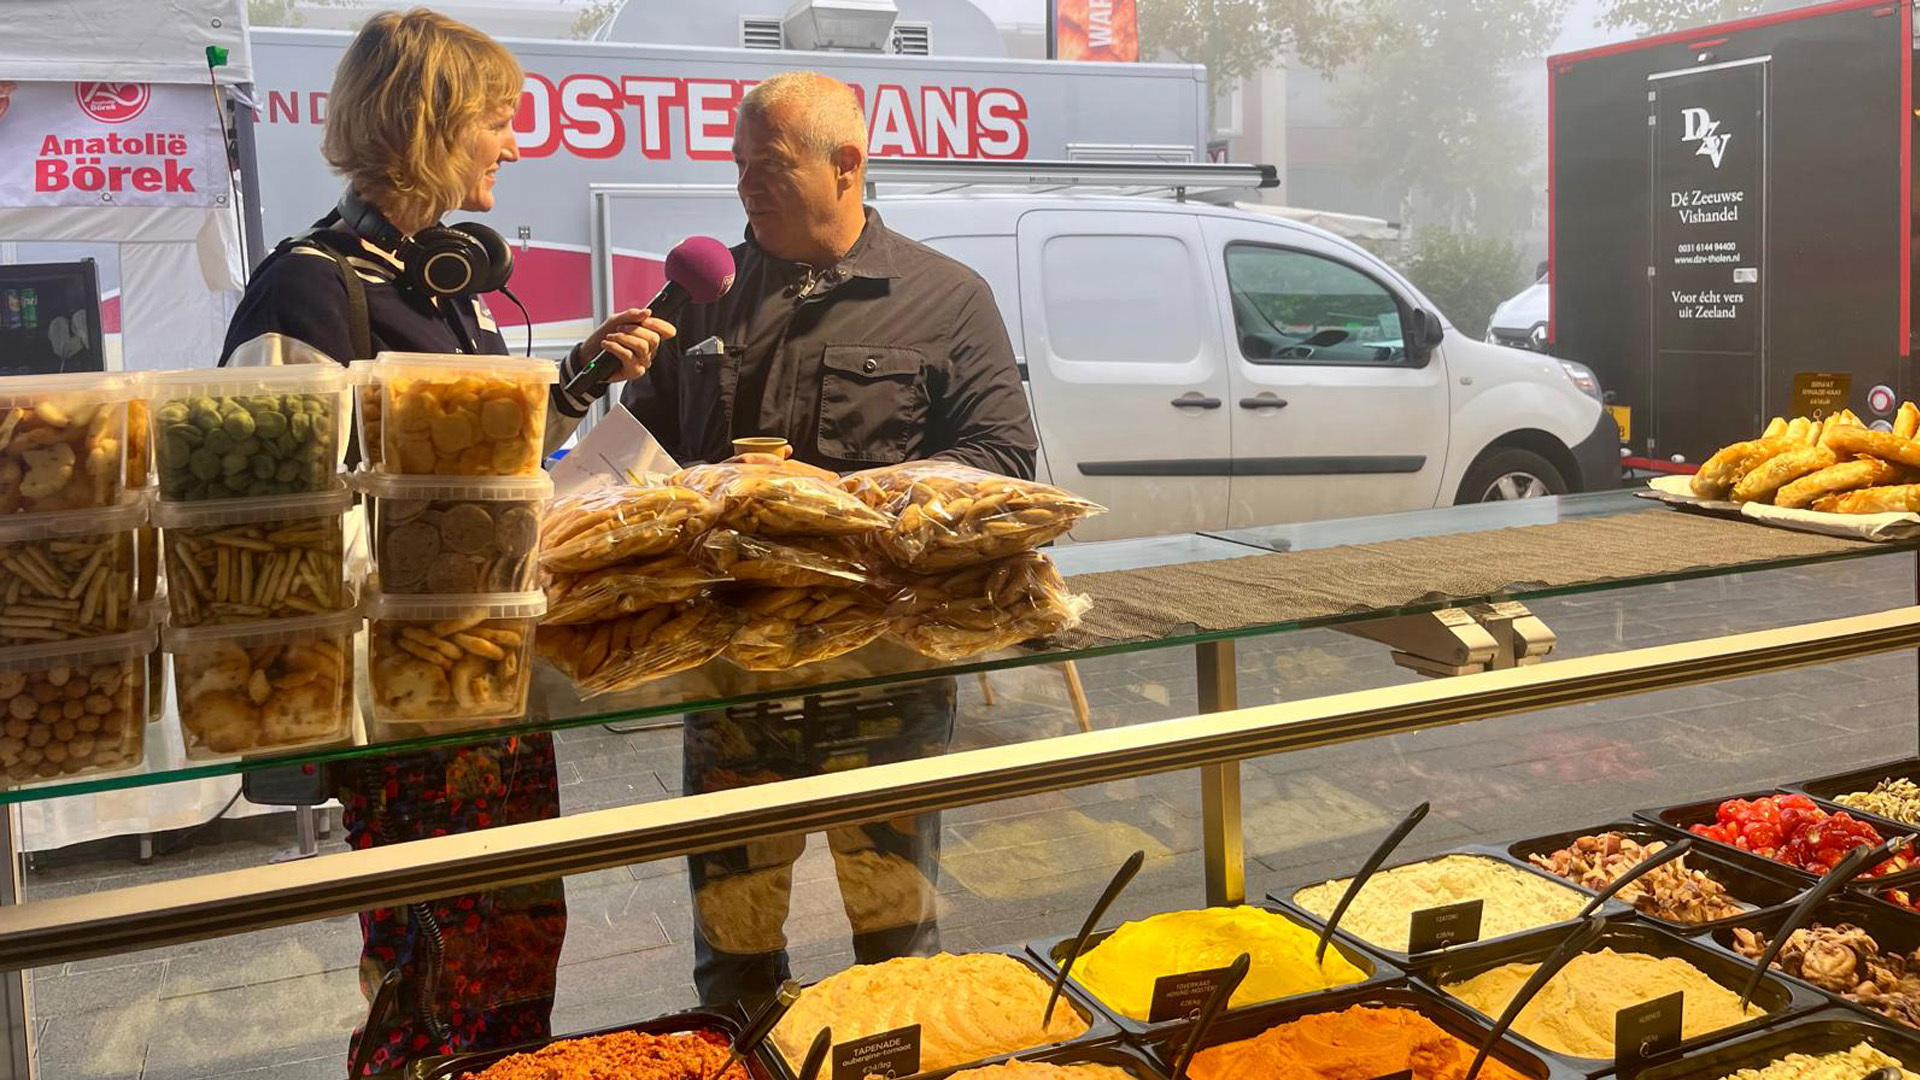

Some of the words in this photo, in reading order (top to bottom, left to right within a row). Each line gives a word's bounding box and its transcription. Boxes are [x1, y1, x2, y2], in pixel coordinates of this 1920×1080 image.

[39, 132, 188, 156] Anatolië
[34, 157, 198, 193] Börek
[1670, 191, 1689, 207] Dé
[1691, 189, 1744, 206] Zeeuwse
[1679, 205, 1738, 224] Vishandel
[1678, 243, 1695, 253] 0031
[1695, 242, 1713, 252] 6144
[1674, 252, 1740, 264] www.dzv-tholen.nl
[1671, 290, 1697, 303] Voor
[1698, 289, 1721, 303] écht
[1722, 293, 1744, 303] vers
[1678, 305, 1693, 318] uit
[1695, 304, 1736, 318] Zeeland
[852, 1037, 903, 1057] TAPENADE
